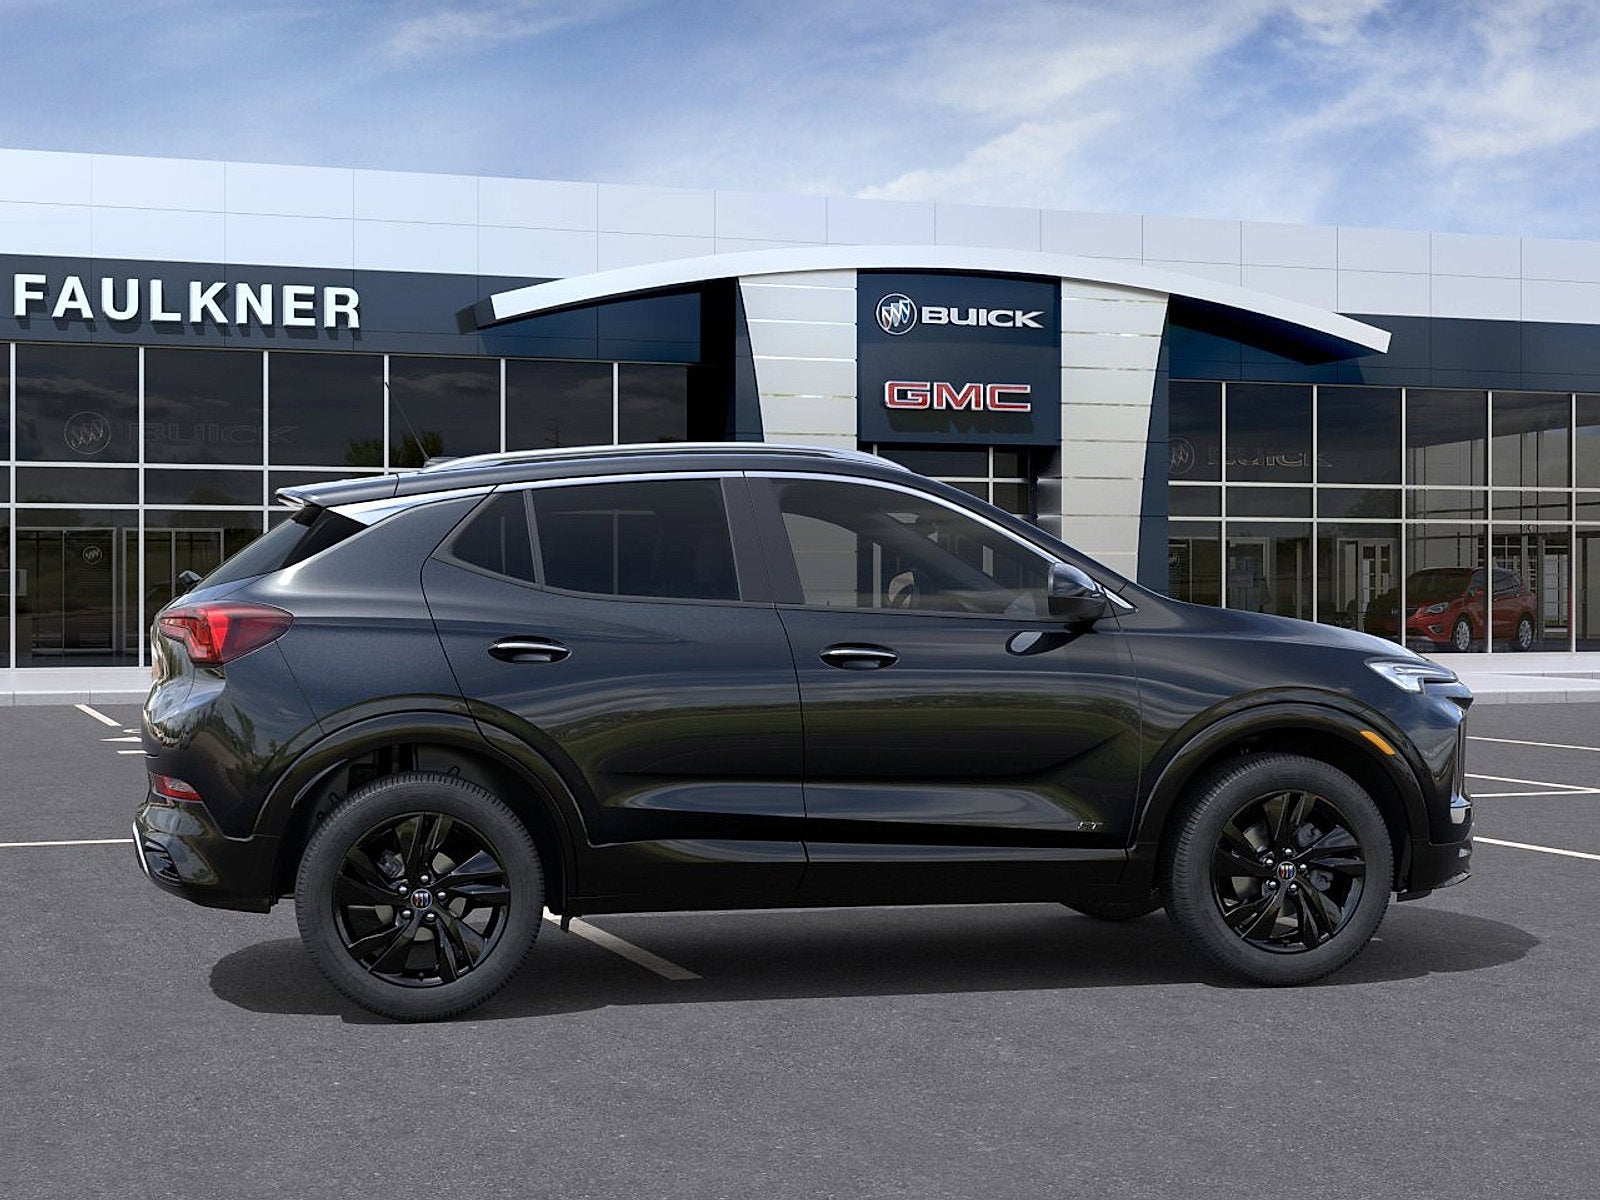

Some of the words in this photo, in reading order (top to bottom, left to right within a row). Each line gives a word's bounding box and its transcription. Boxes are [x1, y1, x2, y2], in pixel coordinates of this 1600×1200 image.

[14, 273, 360, 329] FAULKNER
[921, 306, 1045, 329] BUICK
[885, 381, 1031, 412] GMC
